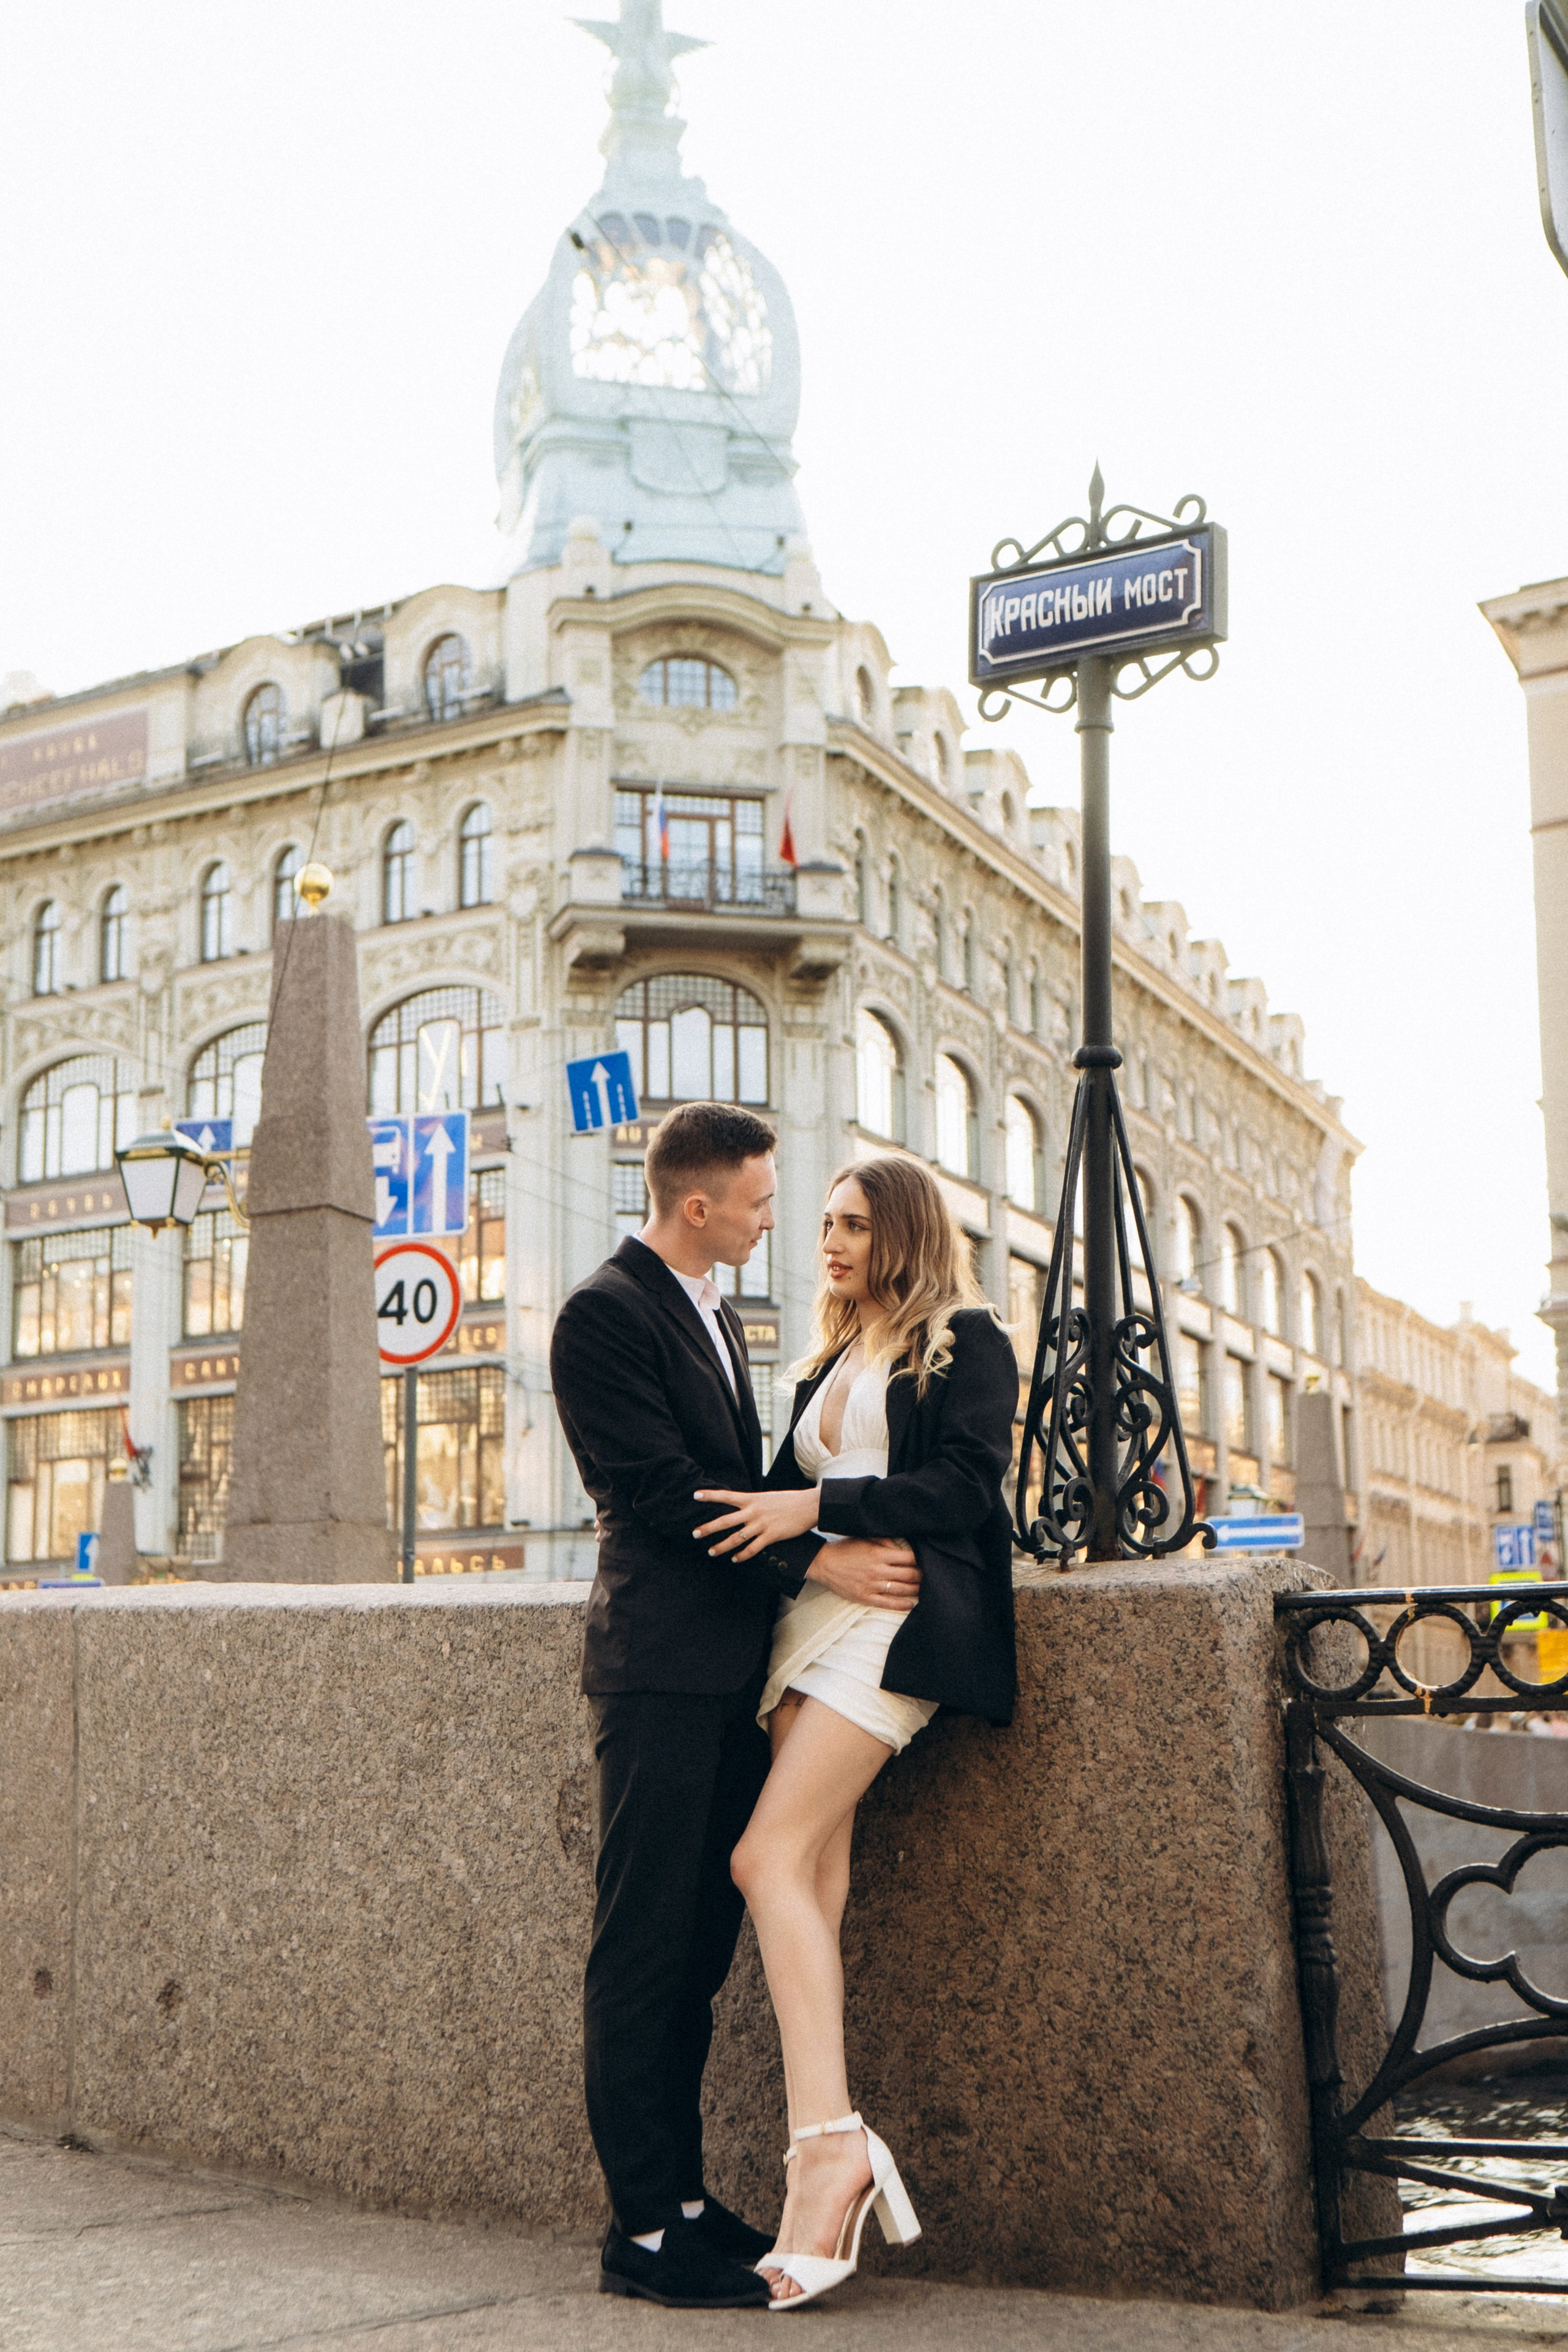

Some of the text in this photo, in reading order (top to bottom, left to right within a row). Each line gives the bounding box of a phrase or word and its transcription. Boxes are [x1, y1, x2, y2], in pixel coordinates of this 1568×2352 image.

[990, 568, 1188, 639] КРАСНЫЙ МОСТ
[378, 1278, 437, 1325] 40
[184, 1357, 240, 1380] GANT
